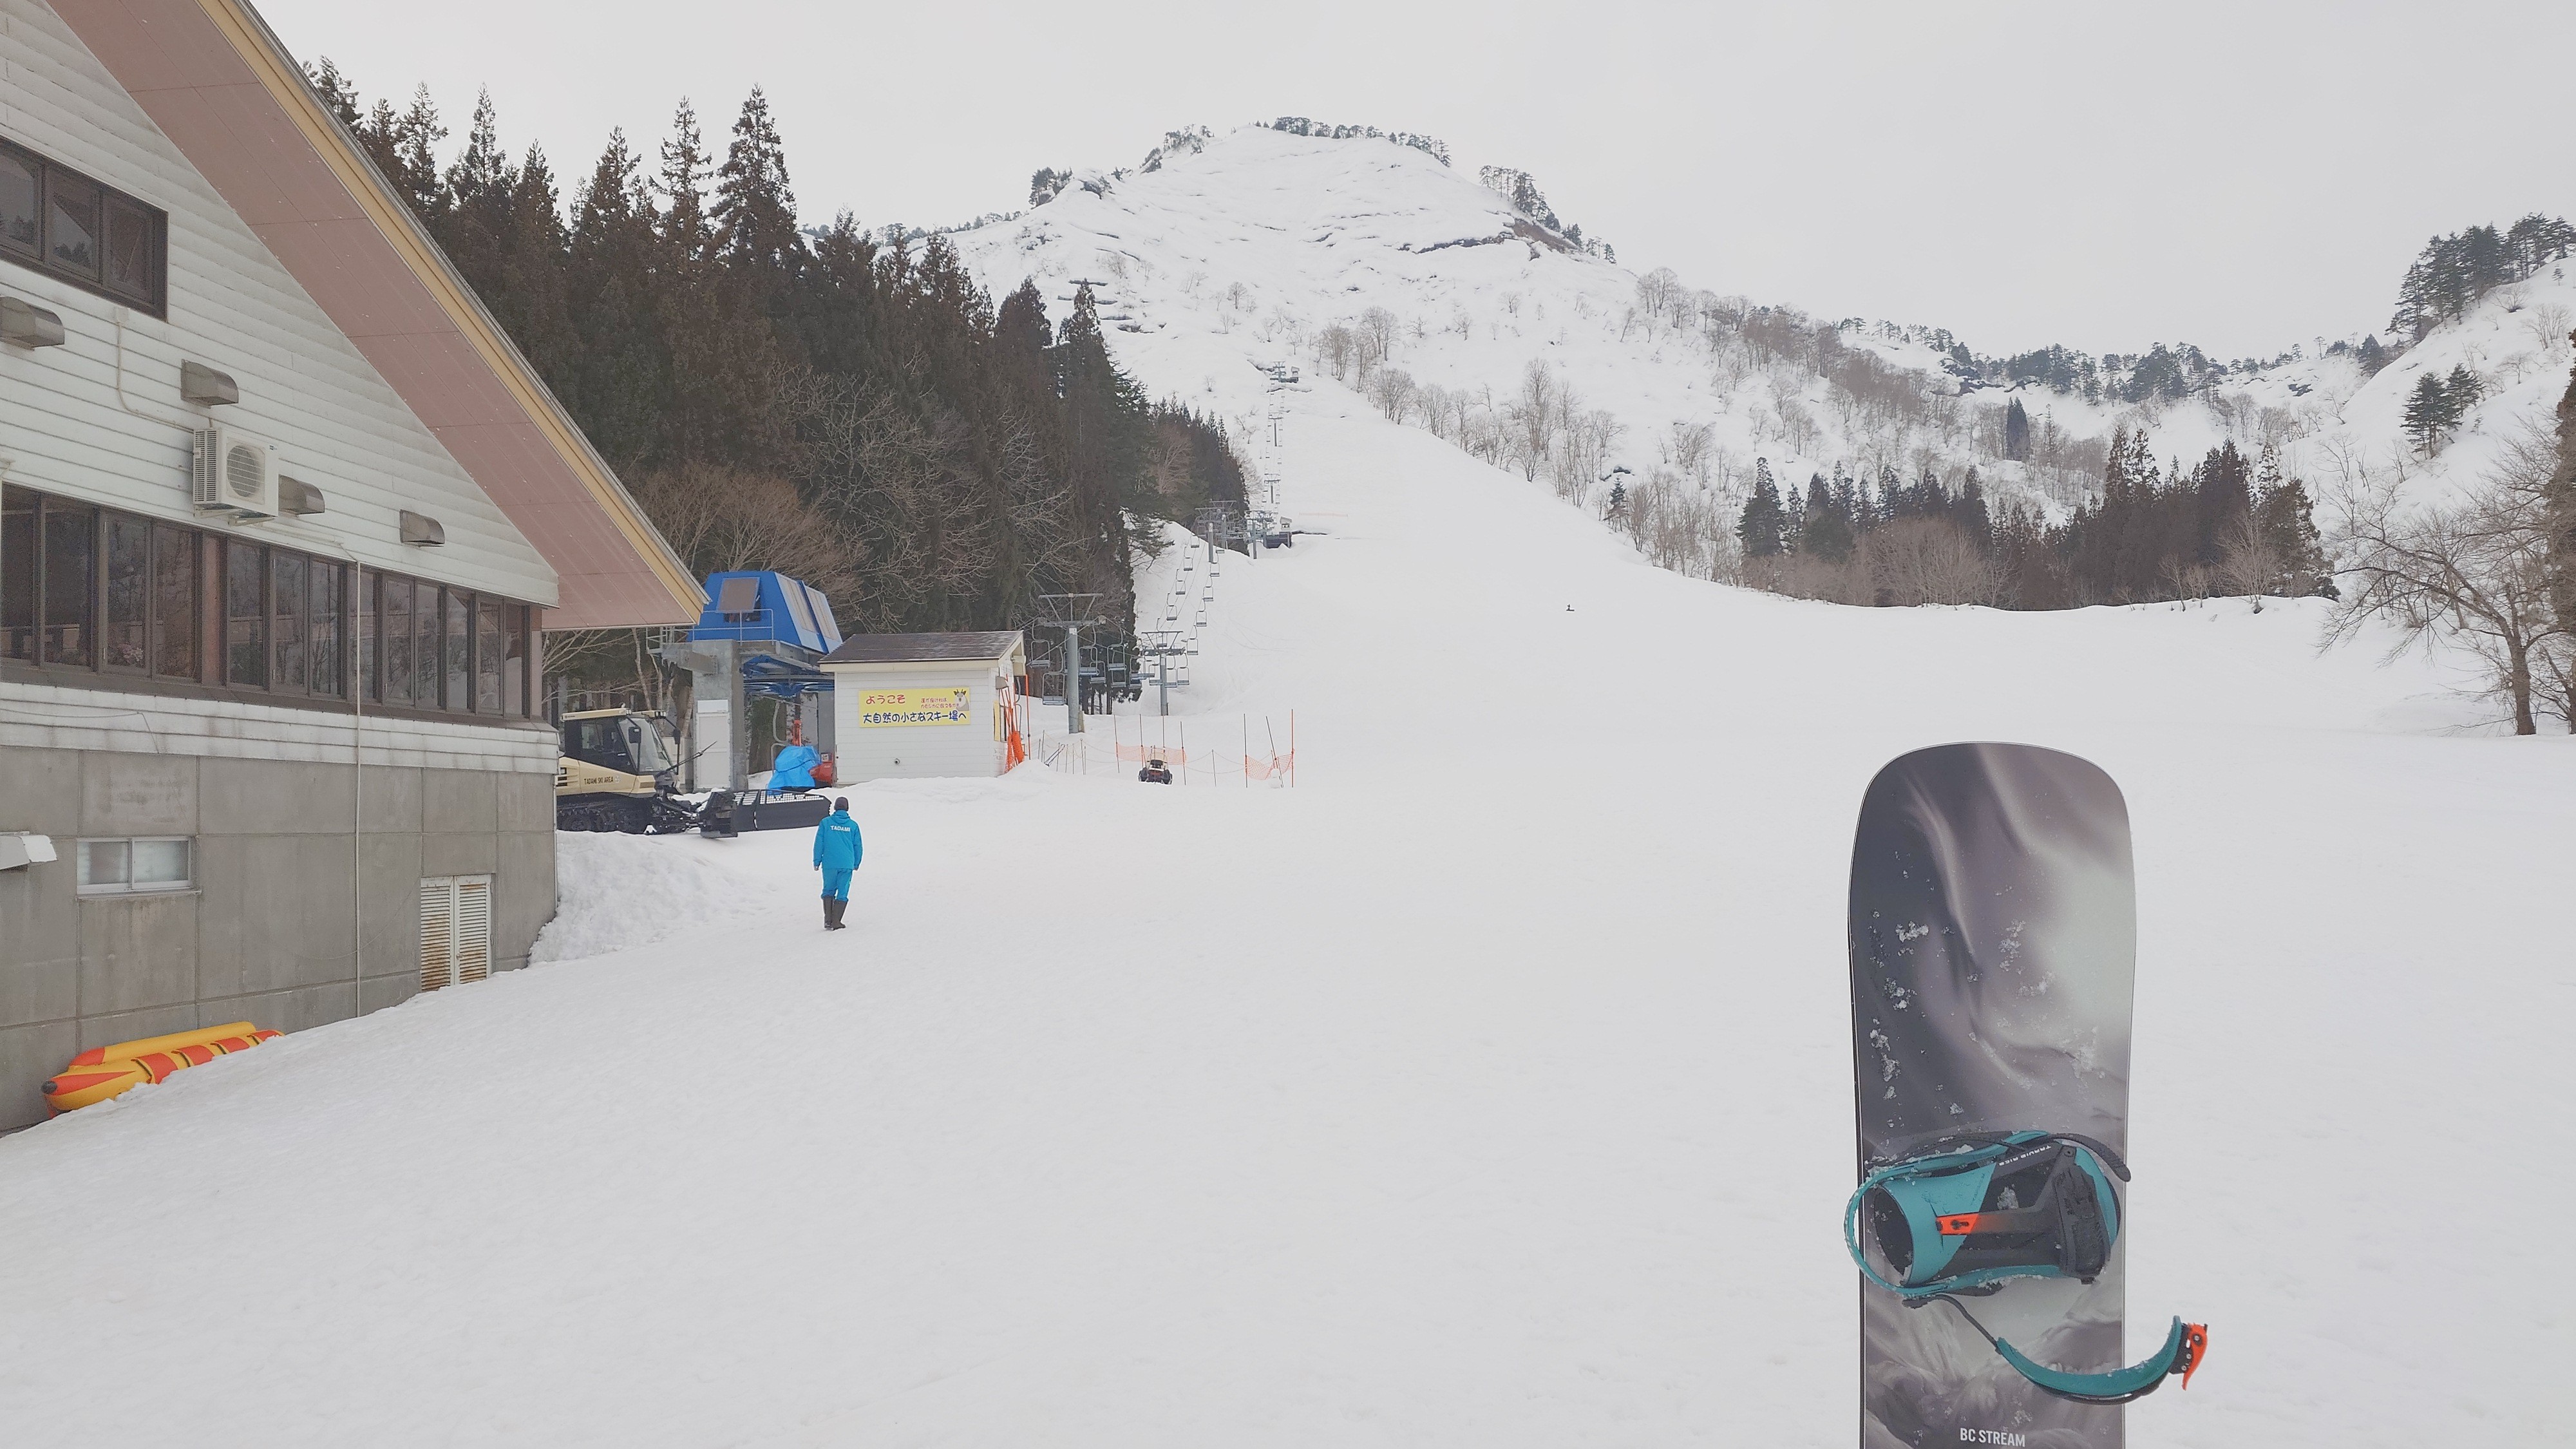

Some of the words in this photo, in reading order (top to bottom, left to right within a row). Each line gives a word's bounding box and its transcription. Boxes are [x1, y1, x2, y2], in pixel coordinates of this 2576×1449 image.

[866, 694, 906, 705] ようこそ
[863, 710, 967, 724] 大自然の小さなスキー場へ
[1960, 1428, 1976, 1442] BC
[1978, 1430, 2025, 1447] STREAM
